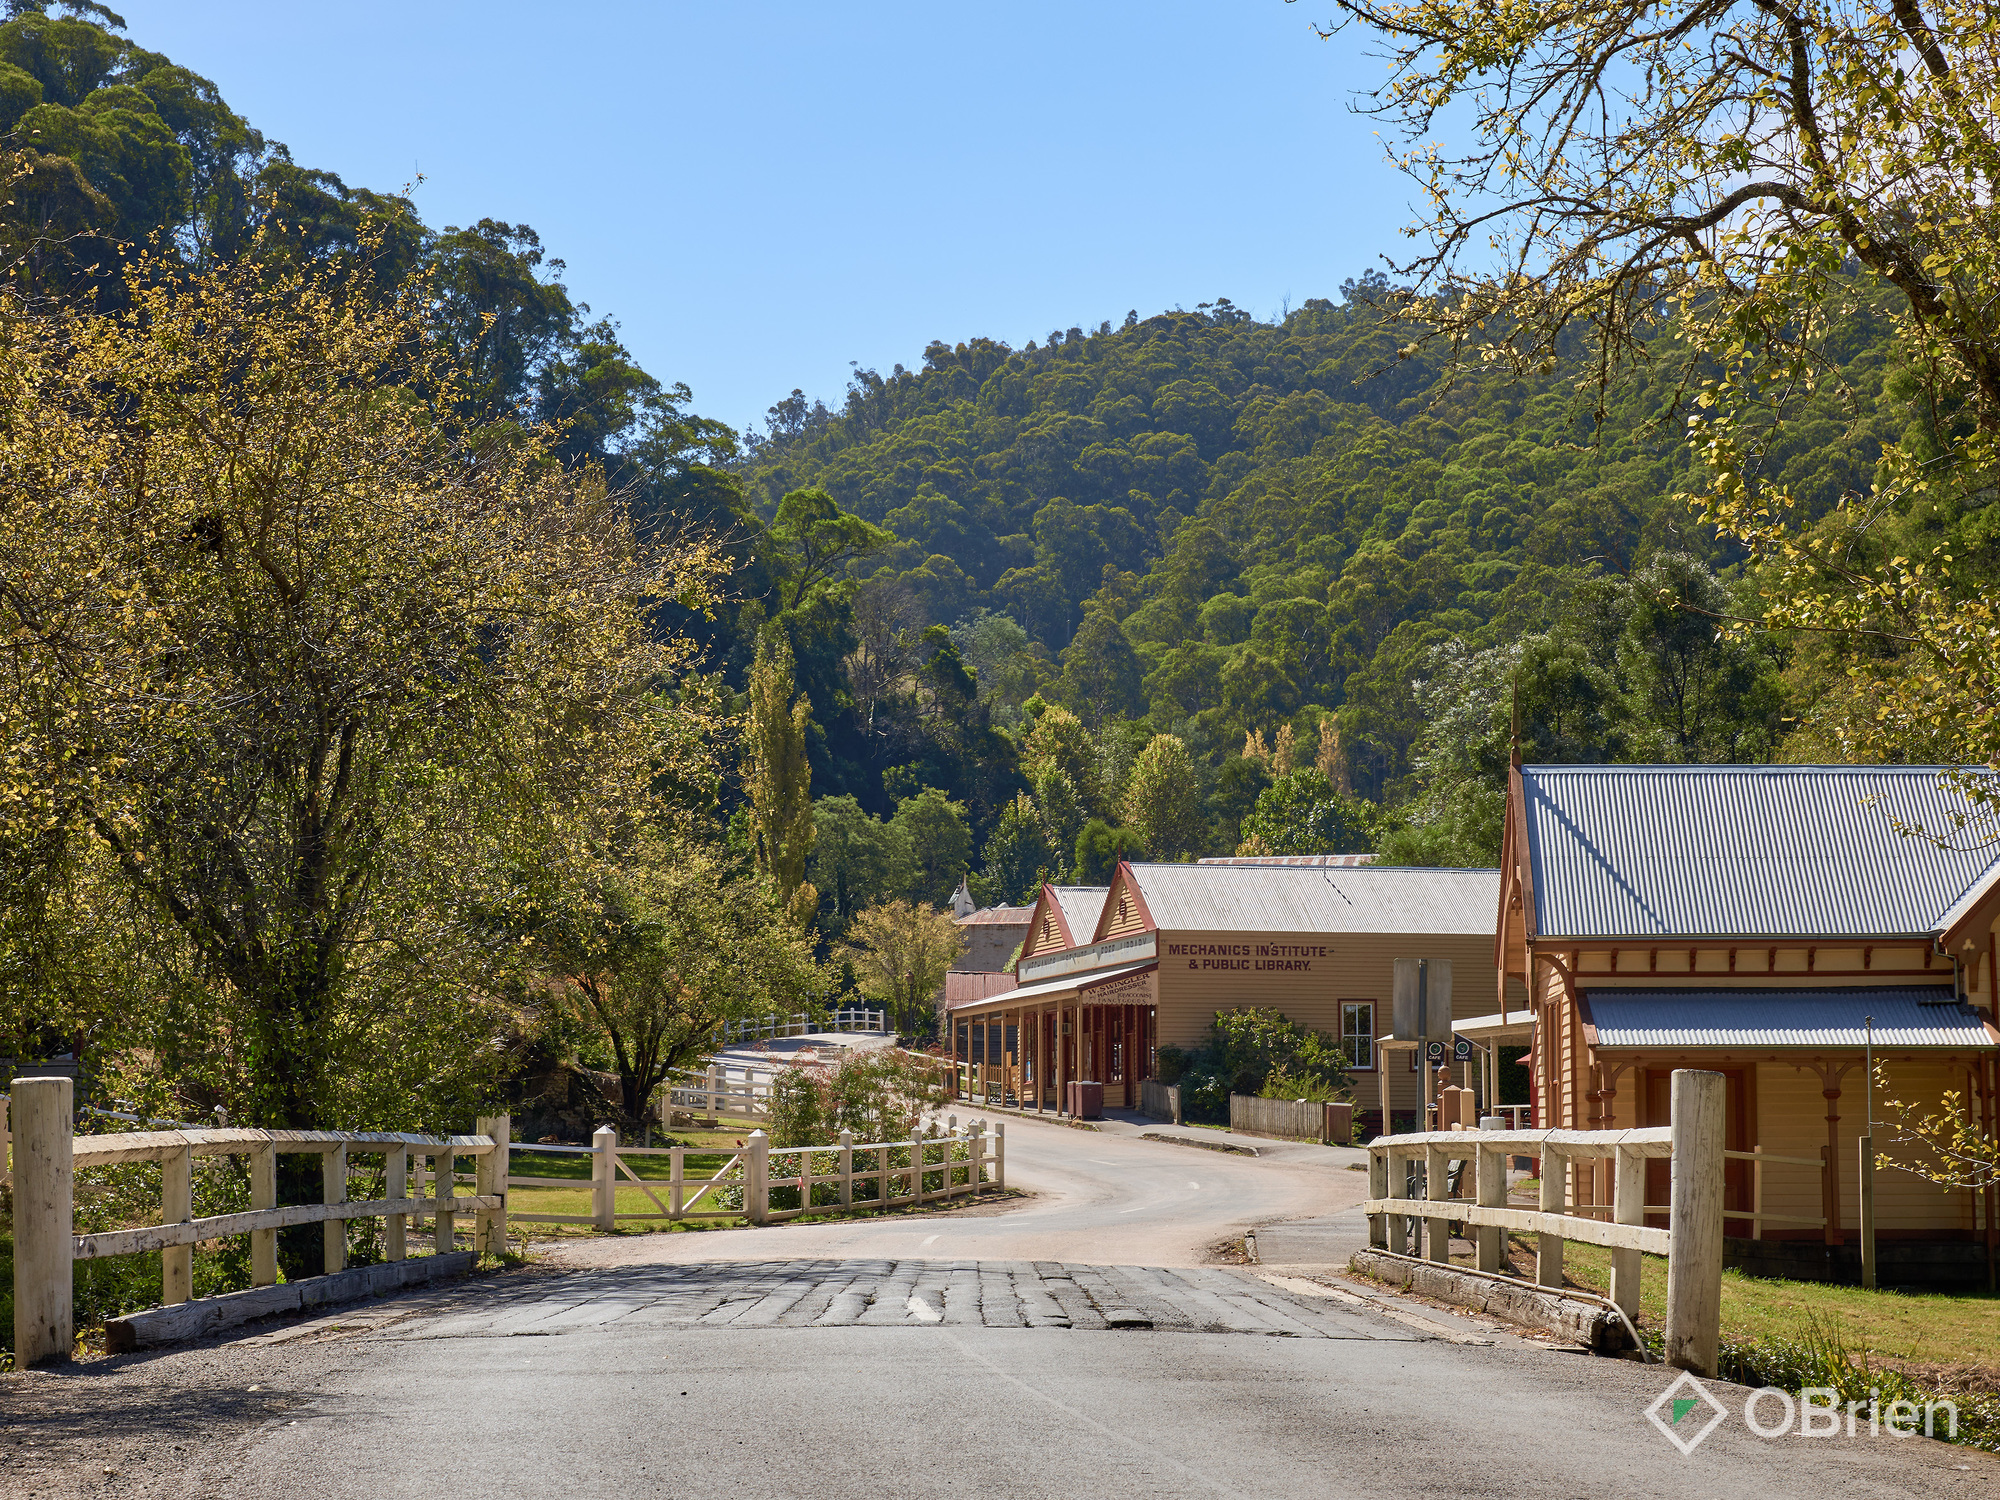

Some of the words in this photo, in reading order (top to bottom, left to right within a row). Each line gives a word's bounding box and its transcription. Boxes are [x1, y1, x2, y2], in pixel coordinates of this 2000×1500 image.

[1168, 944, 1250, 956] MECHANICS
[1256, 945, 1327, 957] INSTITUTE
[1188, 959, 1199, 970] &
[1203, 959, 1250, 970] PUBLIC
[1255, 960, 1312, 971] LIBRARY.
[1097, 980, 1147, 998] HAIRDRESSER
